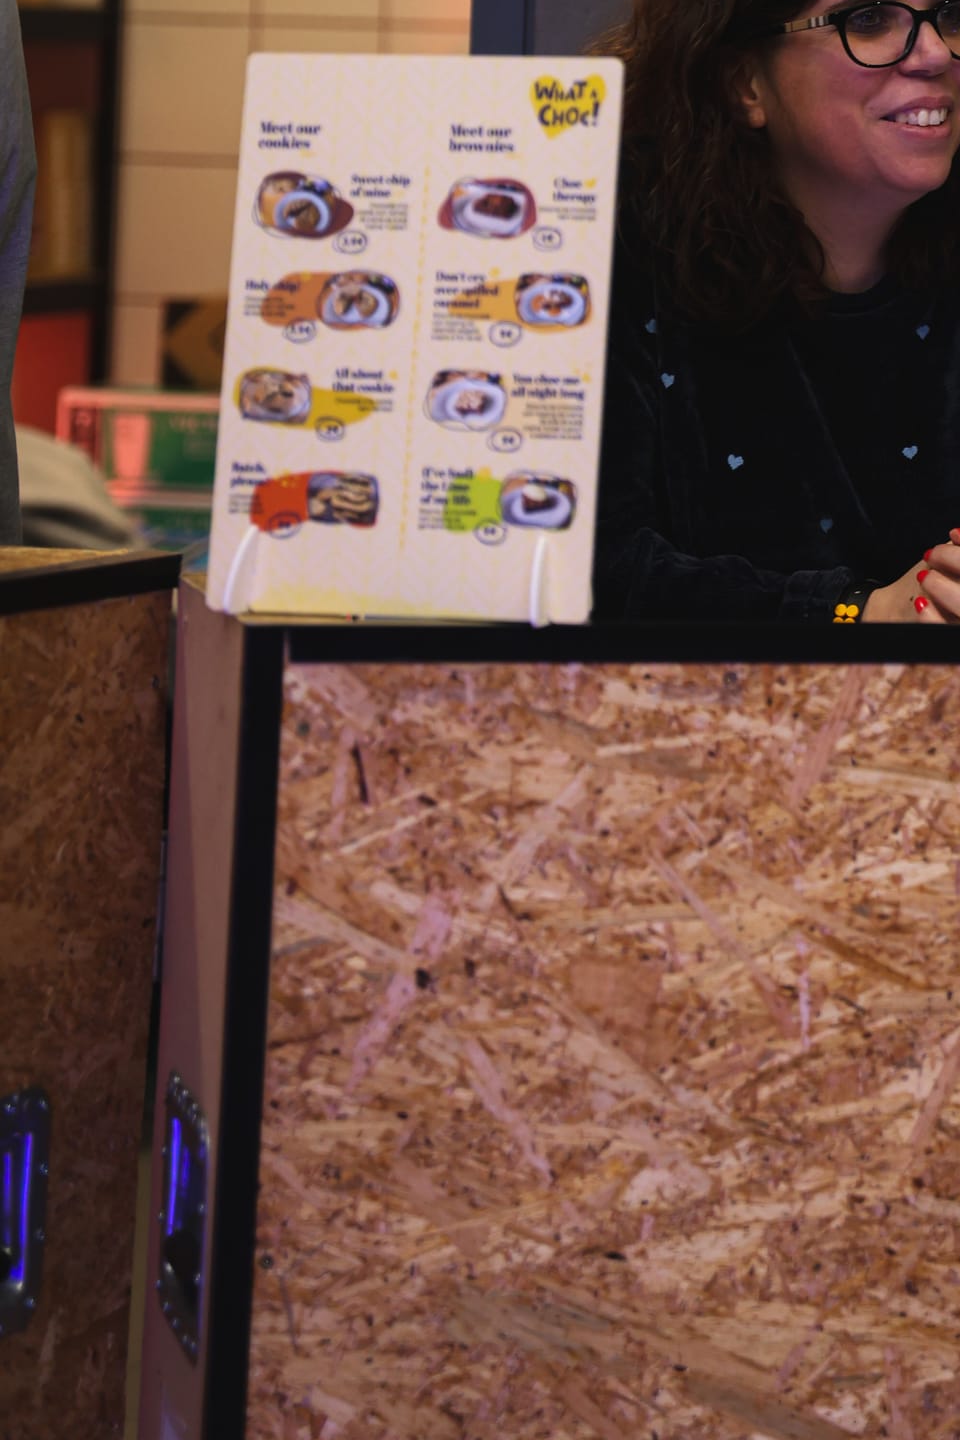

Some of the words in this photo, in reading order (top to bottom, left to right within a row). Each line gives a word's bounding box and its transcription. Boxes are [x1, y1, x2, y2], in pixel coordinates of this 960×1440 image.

[534, 79, 588, 102] WHAT
[590, 88, 598, 99] A
[538, 101, 600, 127] CHOC!
[260, 122, 293, 134] Meet
[296, 124, 321, 135] our
[451, 125, 483, 137] Meet
[487, 126, 512, 138] our
[258, 137, 311, 149] cookies
[449, 139, 515, 153] brownies
[351, 174, 384, 185] Sweet
